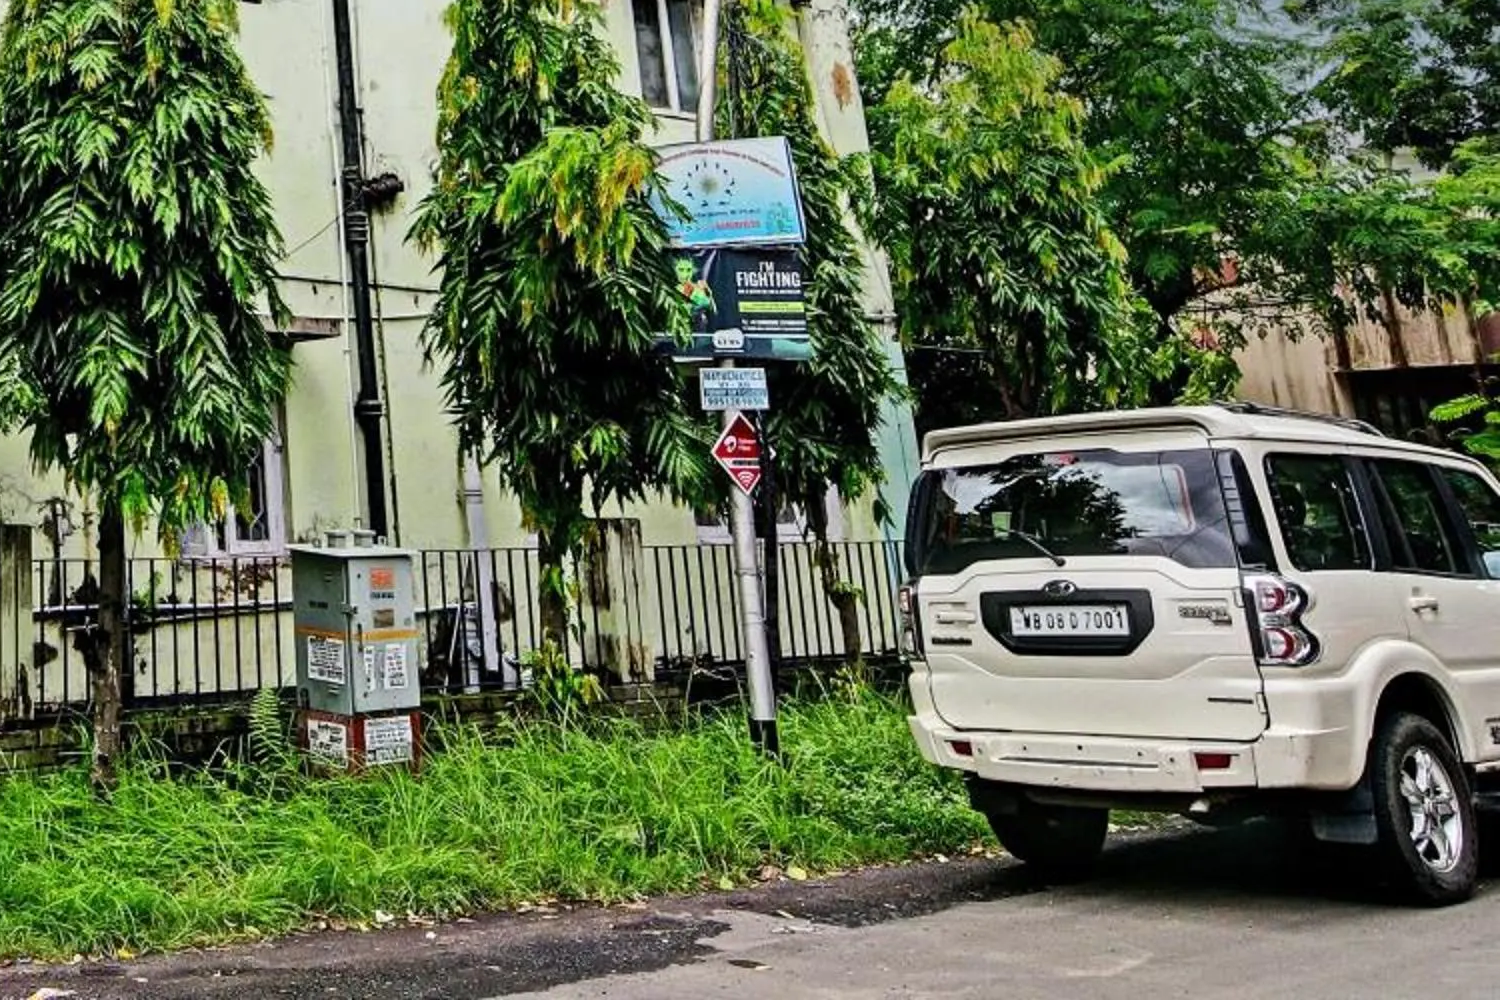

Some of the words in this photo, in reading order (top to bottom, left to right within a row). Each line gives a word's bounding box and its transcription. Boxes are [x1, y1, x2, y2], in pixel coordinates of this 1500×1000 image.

[735, 271, 801, 287] FIGHTING
[1023, 611, 1042, 630] WB
[1083, 611, 1124, 630] 7001
